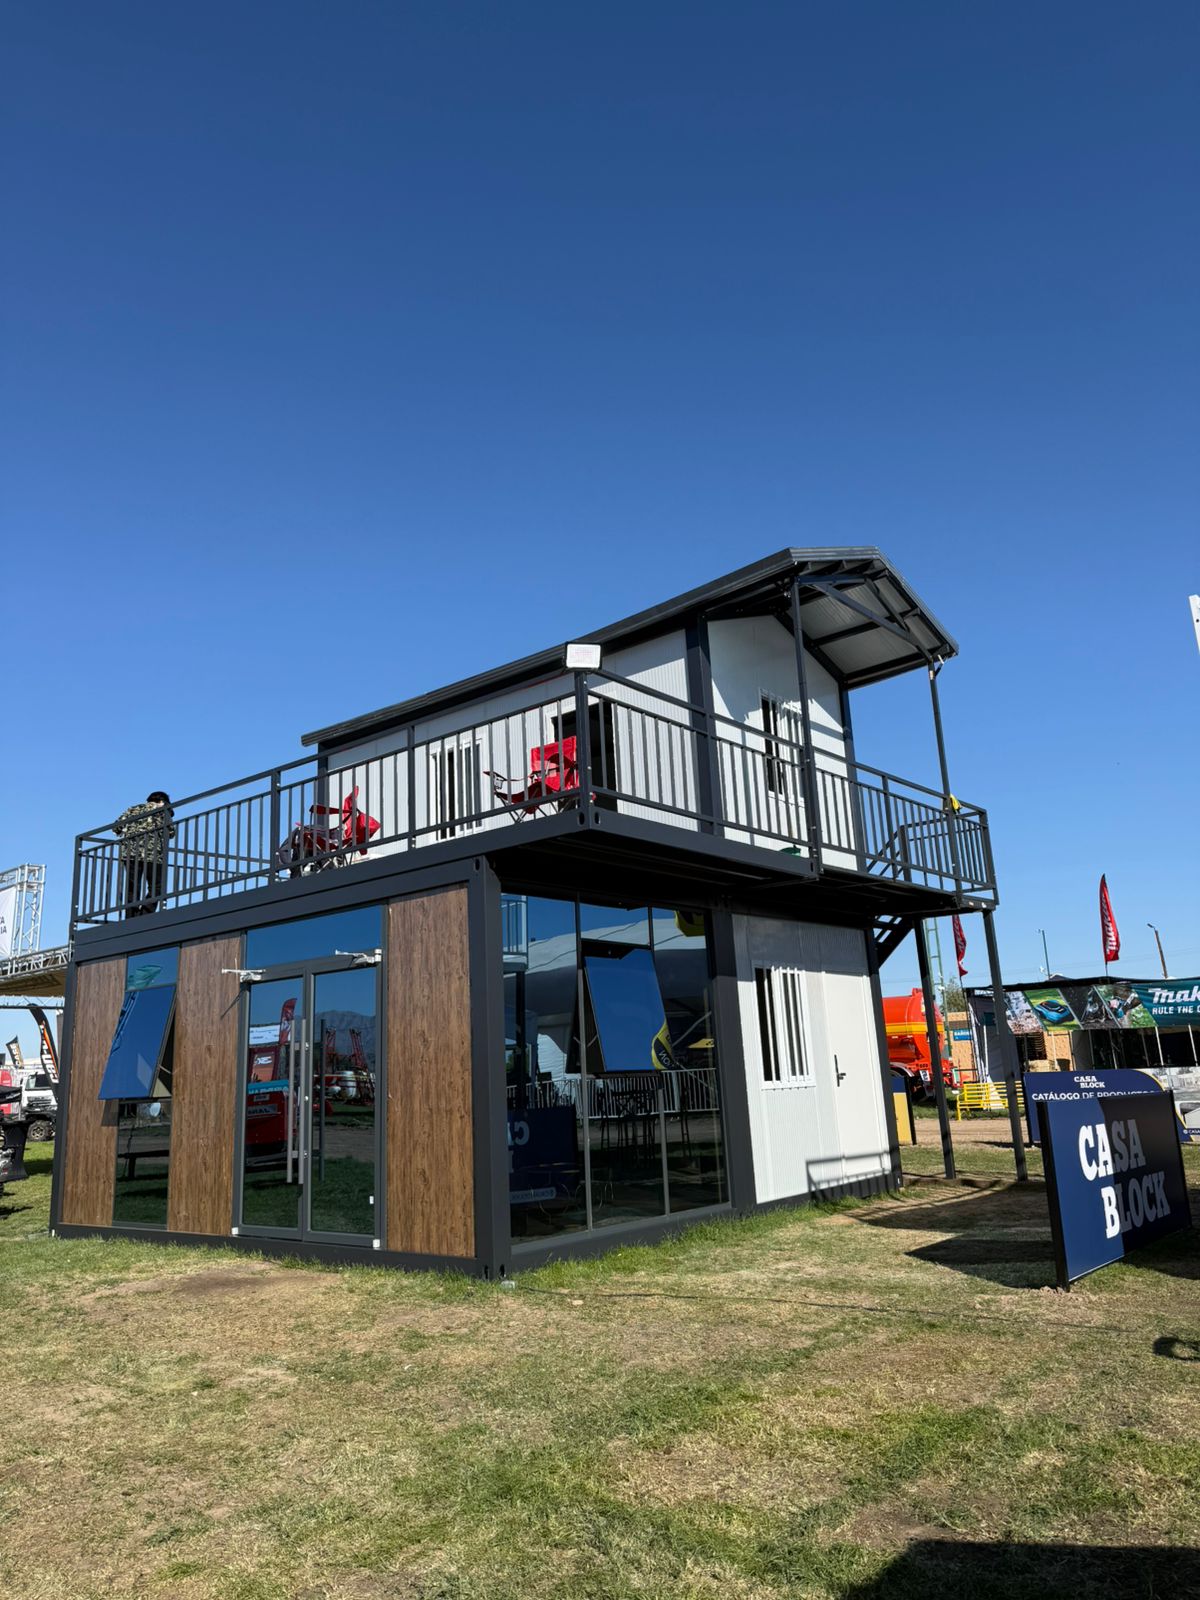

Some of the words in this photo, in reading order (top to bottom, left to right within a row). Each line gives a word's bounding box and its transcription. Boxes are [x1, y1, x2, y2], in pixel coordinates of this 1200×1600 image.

[1152, 1006, 1174, 1015] RULE
[1177, 1005, 1194, 1014] THE
[1032, 1091, 1080, 1101] CATÁLOGO
[1078, 1119, 1146, 1181] CASA
[1100, 1171, 1171, 1239] BLOCK
